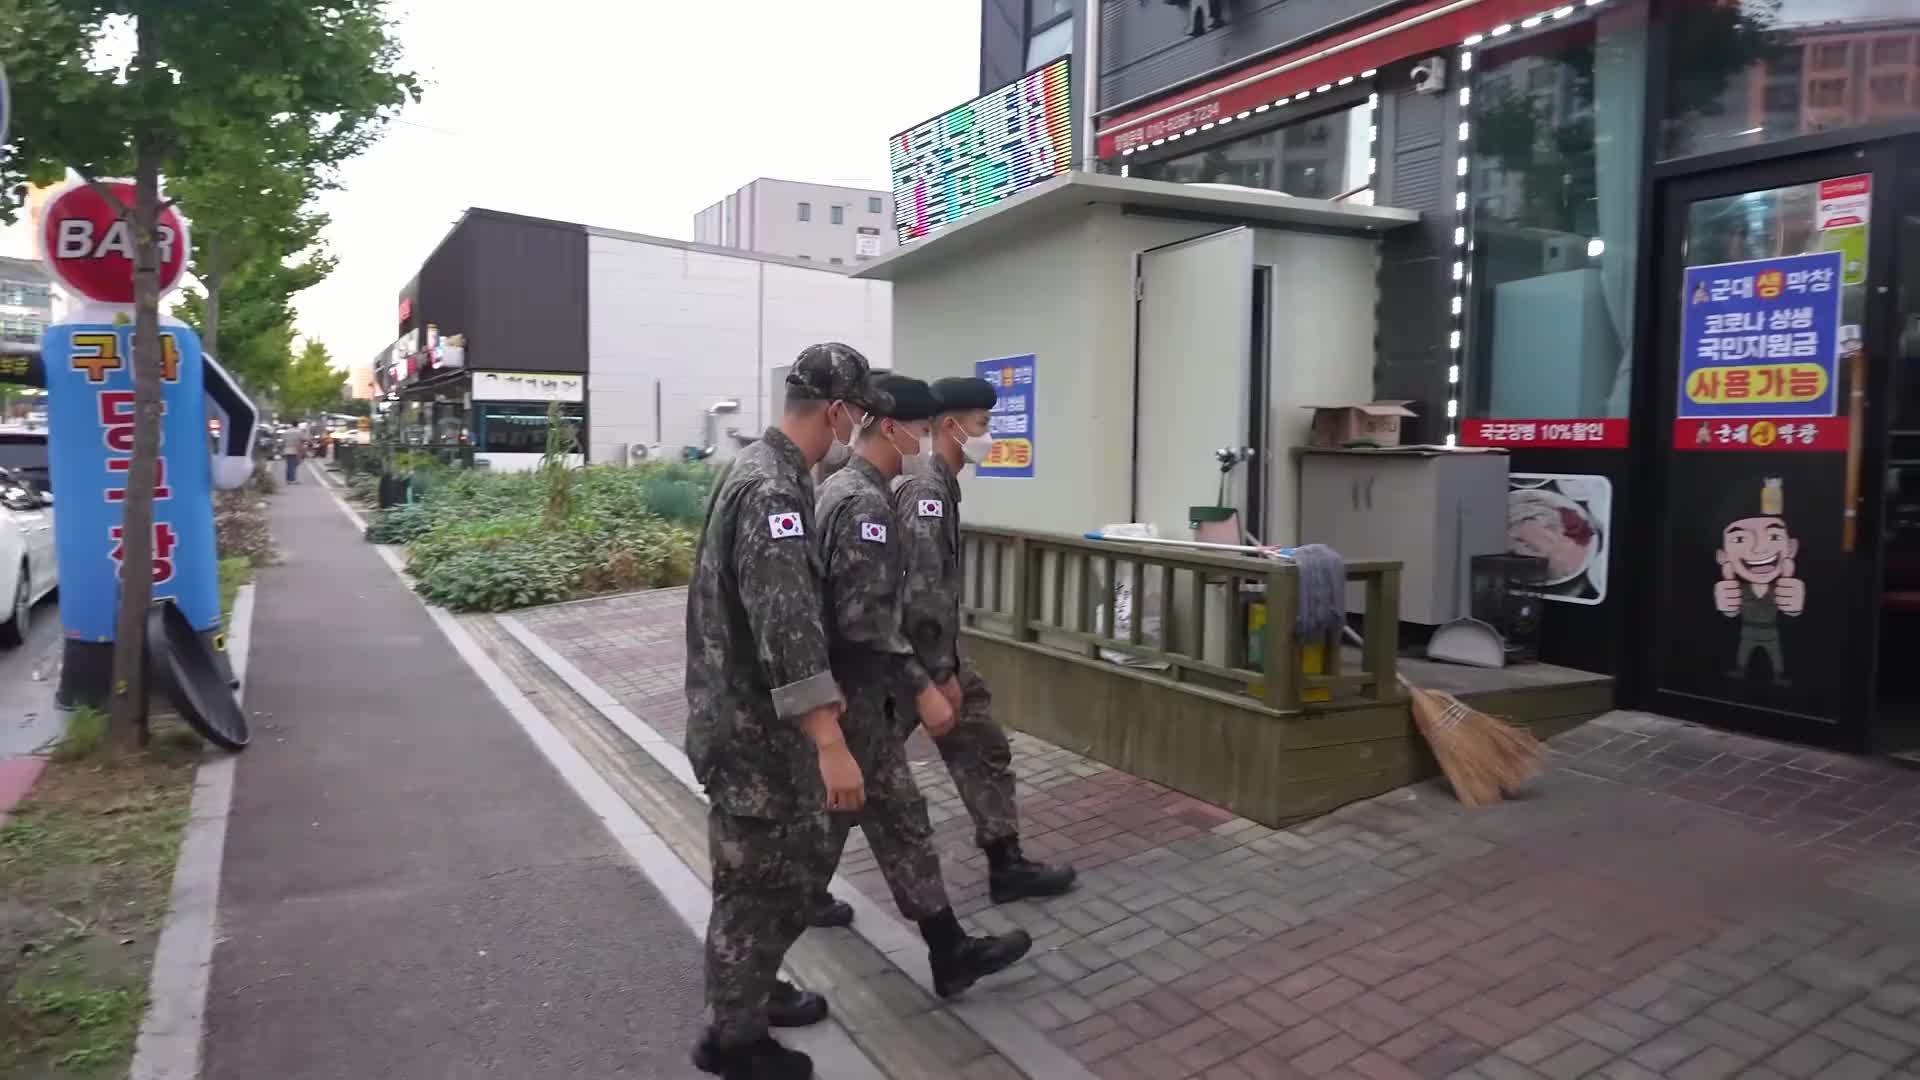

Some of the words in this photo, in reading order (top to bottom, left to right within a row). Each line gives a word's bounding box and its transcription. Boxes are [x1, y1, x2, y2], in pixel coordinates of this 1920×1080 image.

[1704, 311, 1765, 334] 코로나
[1769, 307, 1813, 330] 상생
[1698, 332, 1819, 361] 국민지원금
[1480, 423, 1536, 441] 국군장병
